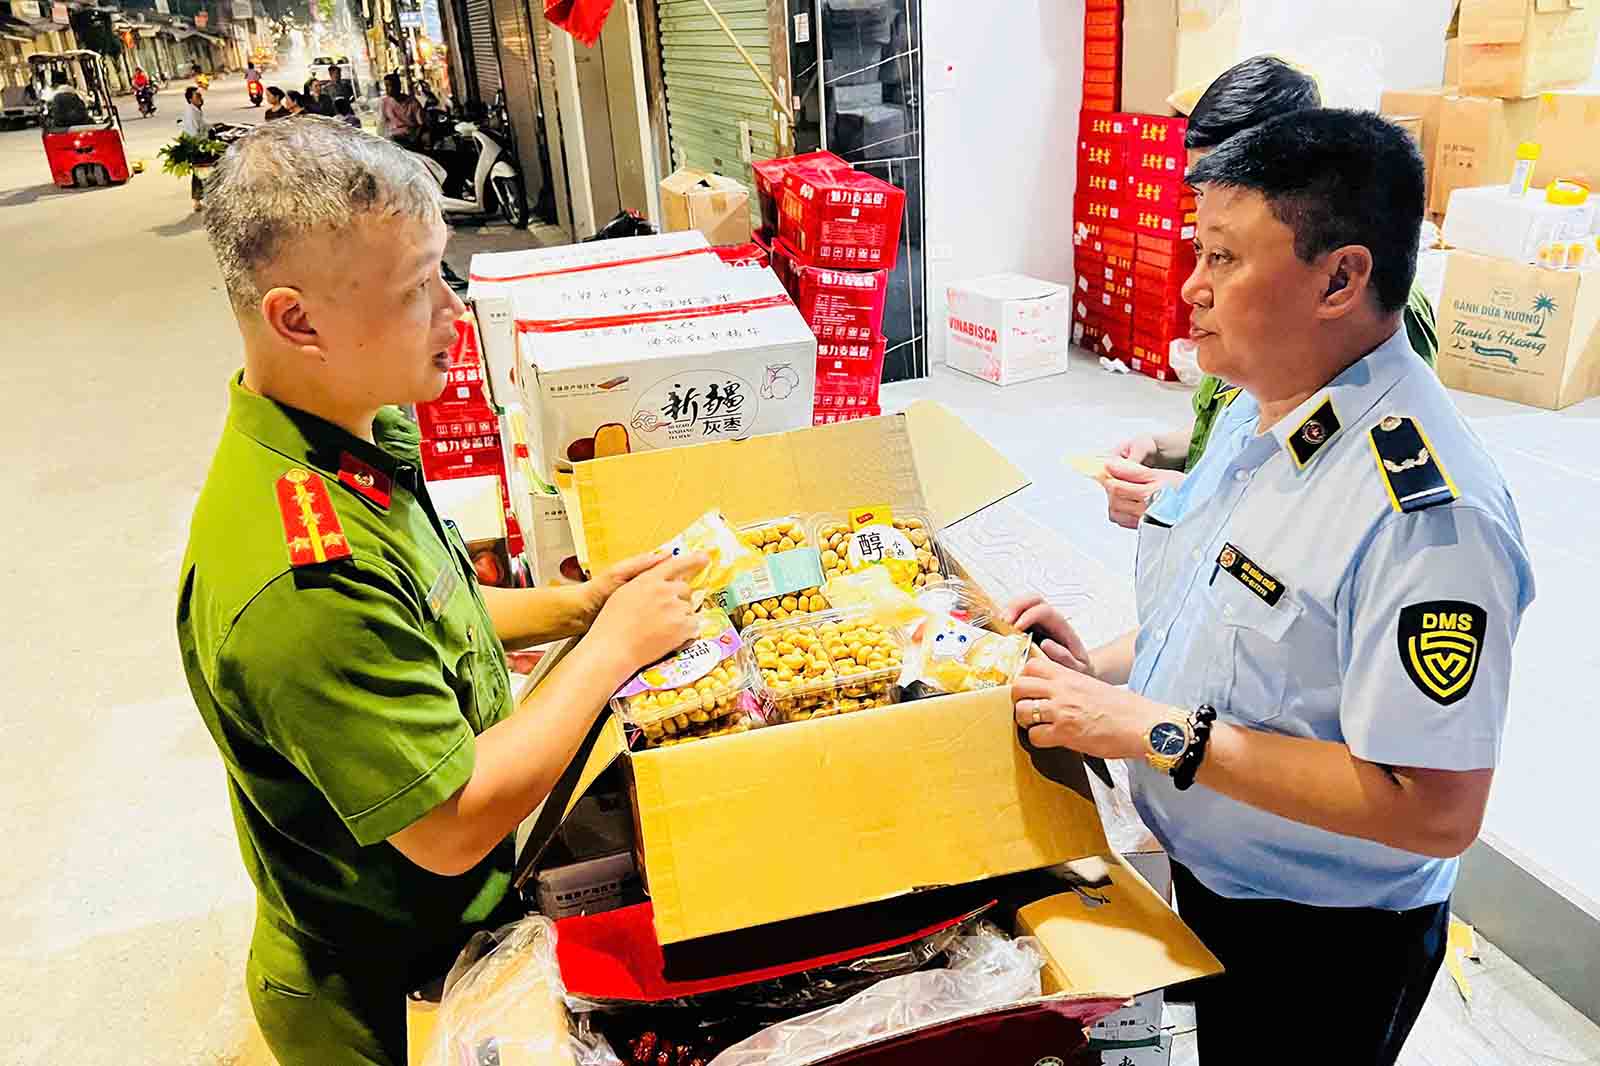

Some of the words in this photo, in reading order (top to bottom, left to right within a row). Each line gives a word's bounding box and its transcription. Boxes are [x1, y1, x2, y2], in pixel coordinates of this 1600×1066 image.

[661, 380, 745, 427] 新疆
[703, 417, 741, 436] 灰枣
[857, 532, 884, 561] 醇
[1423, 612, 1473, 631] DMS
